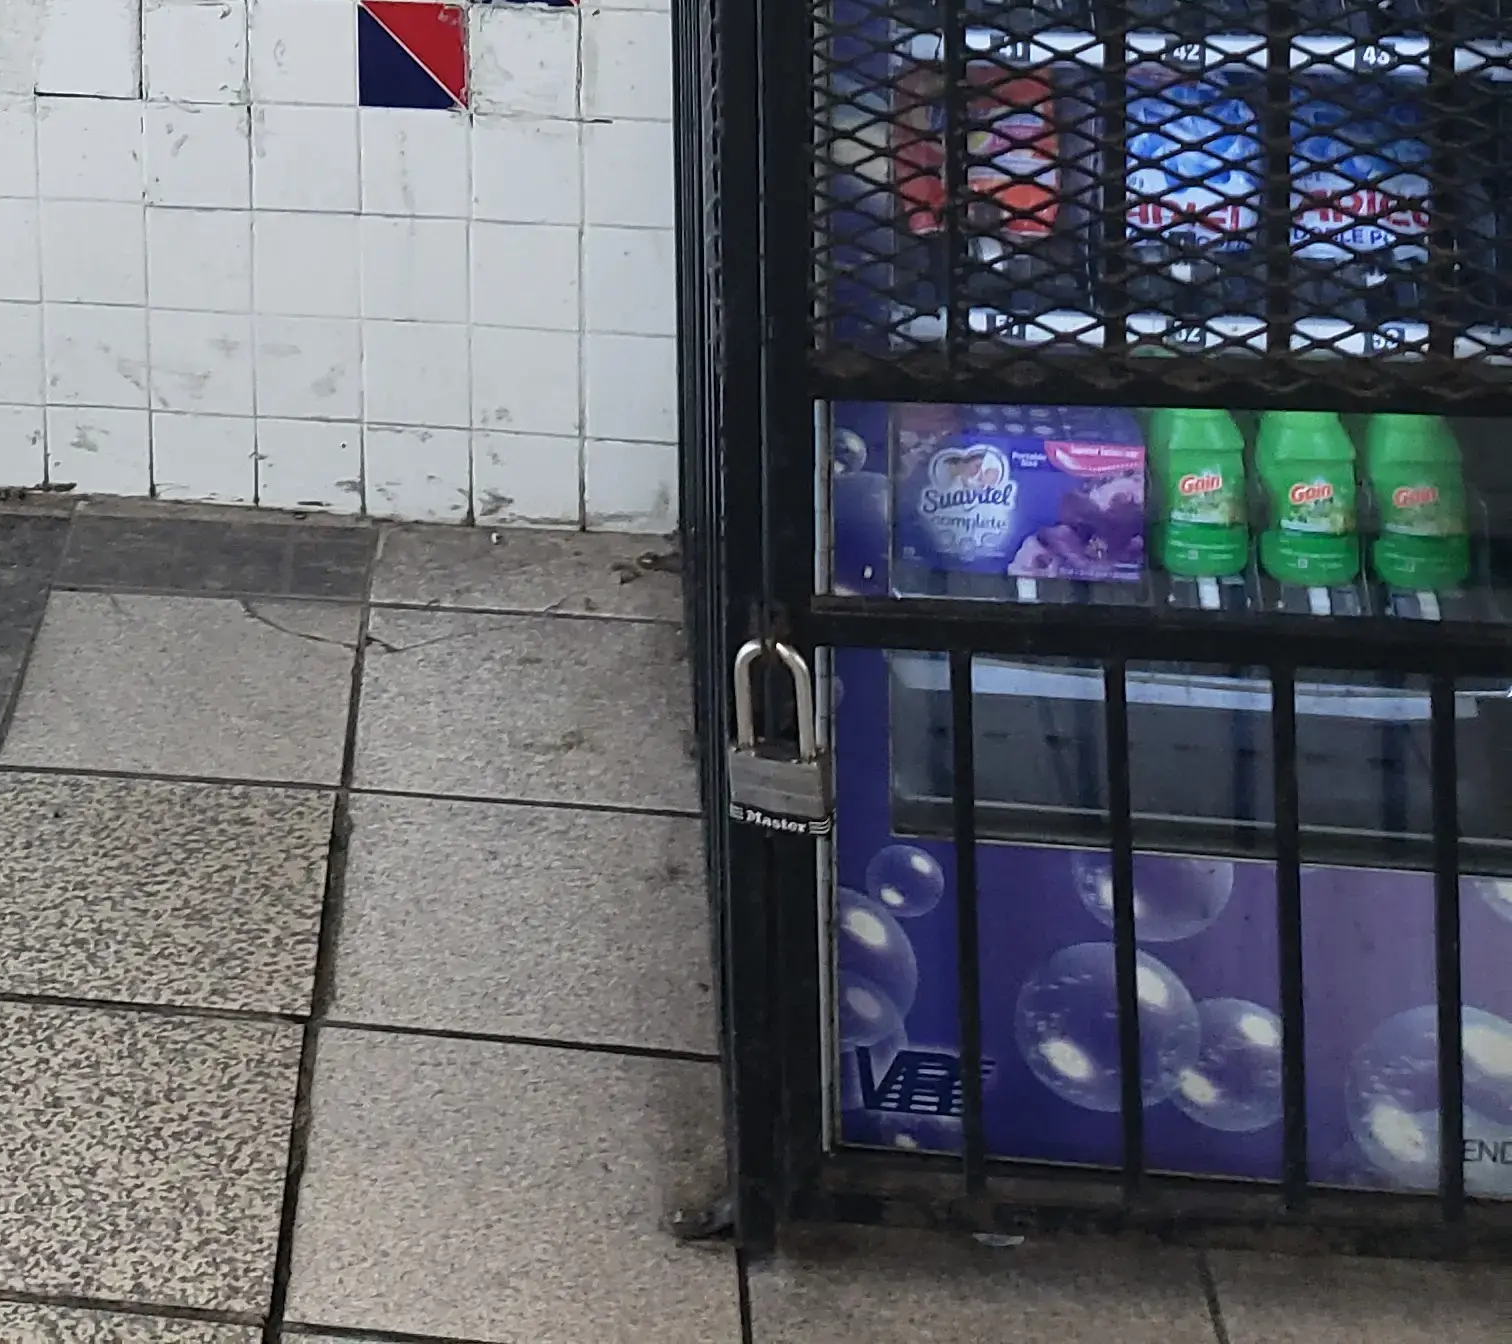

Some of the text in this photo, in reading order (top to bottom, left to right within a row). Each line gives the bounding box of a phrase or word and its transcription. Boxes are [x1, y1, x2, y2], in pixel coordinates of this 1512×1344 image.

[1179, 473, 1223, 495] Gain
[1290, 482, 1335, 505] Gain
[922, 483, 1013, 514] Suavitel
[1393, 486, 1437, 508] Gain
[745, 809, 807, 833] Master
